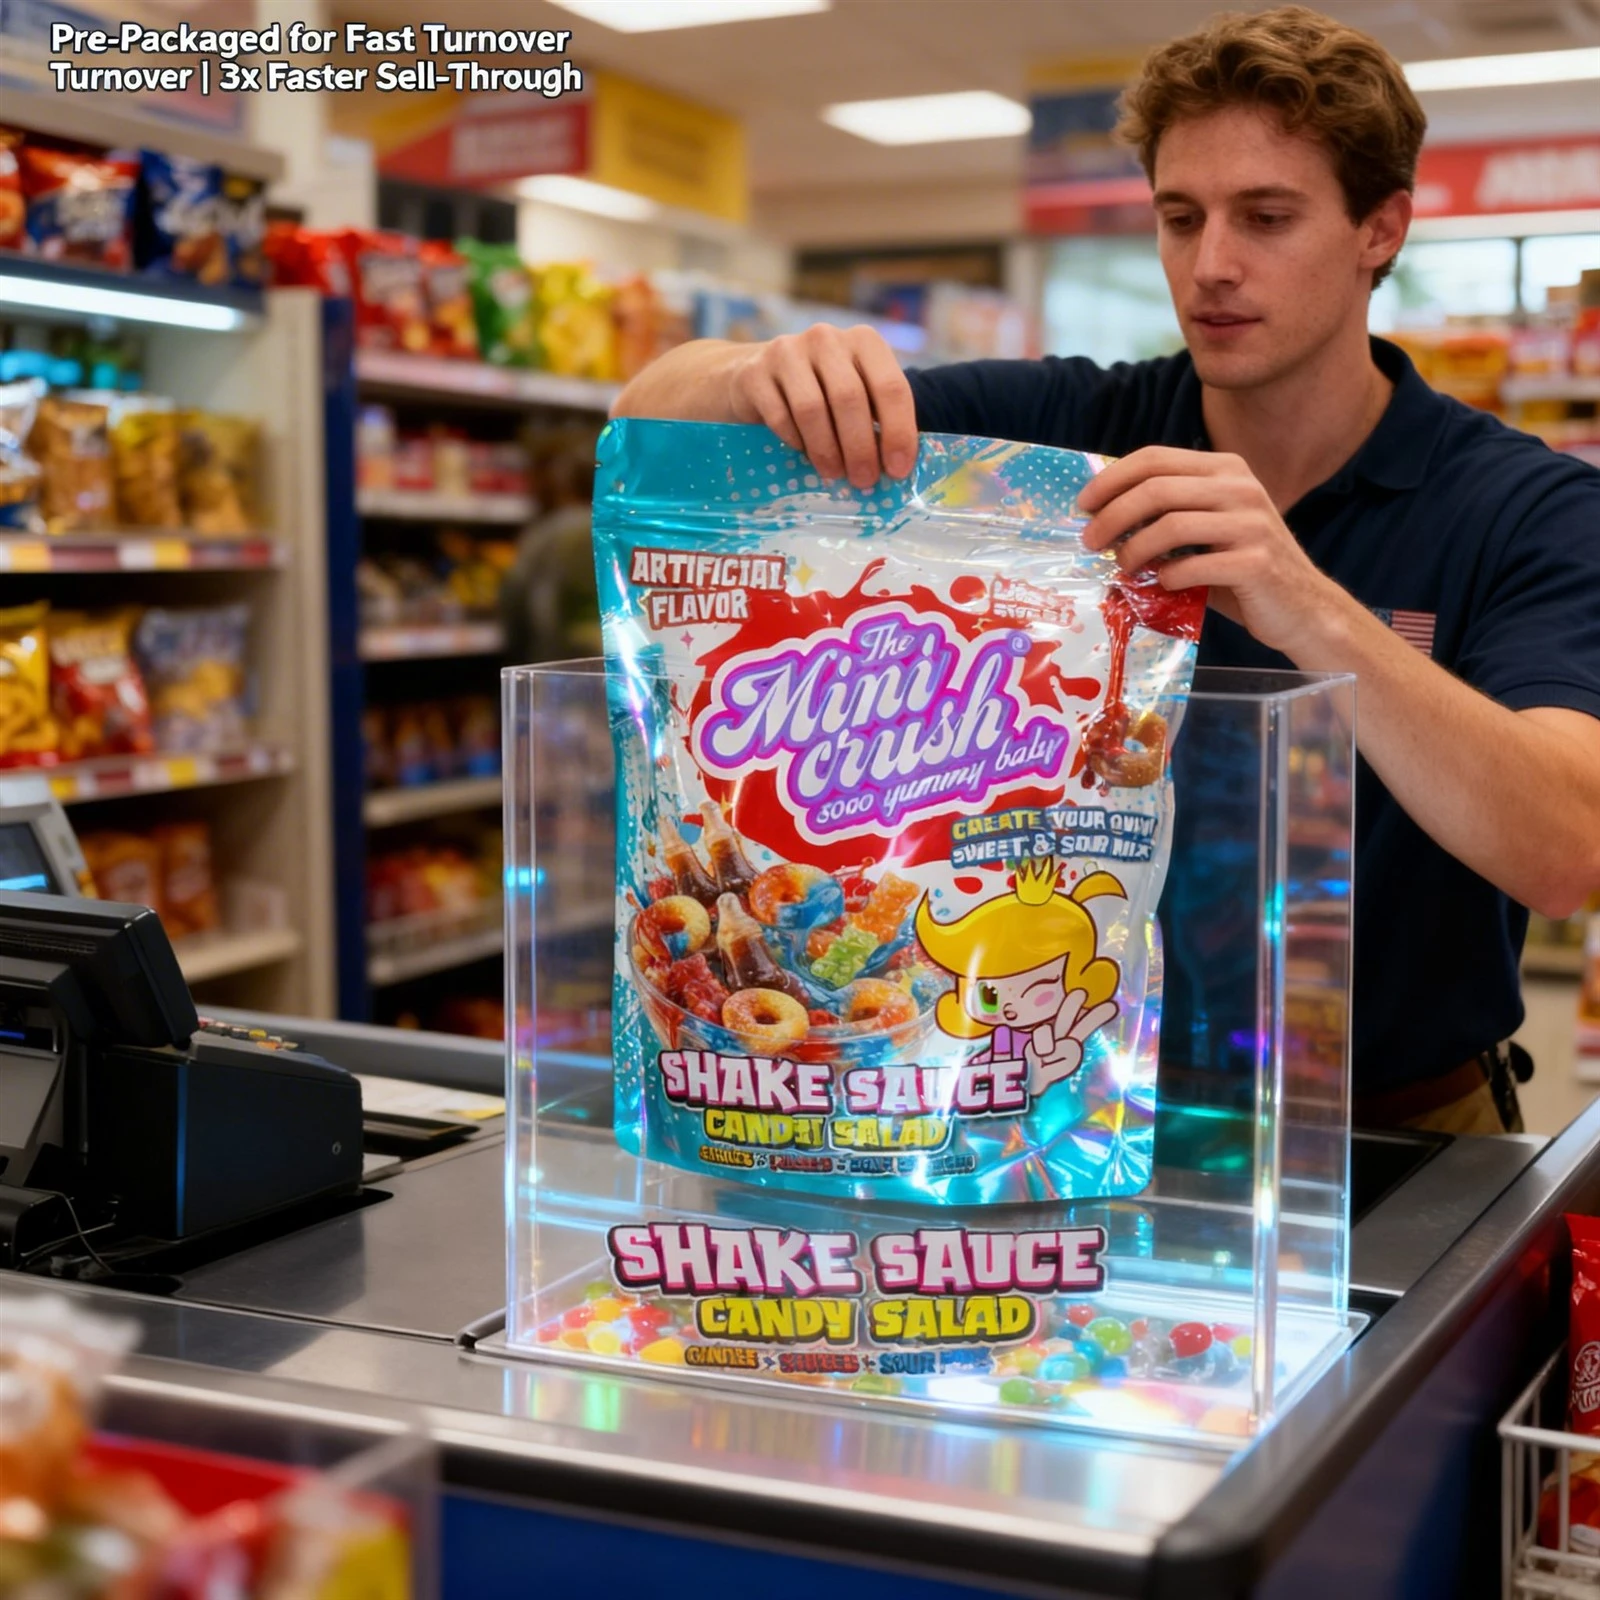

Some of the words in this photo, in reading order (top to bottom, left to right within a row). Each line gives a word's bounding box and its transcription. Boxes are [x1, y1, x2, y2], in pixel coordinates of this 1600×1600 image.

[631, 551, 786, 591] ARTIFICIAL
[652, 588, 749, 626] FLAVOR
[858, 621, 915, 663] The
[713, 630, 942, 757] Mini
[797, 650, 1004, 799] crush
[880, 758, 988, 817] yummy
[659, 1049, 835, 1115] SHAKE
[842, 1058, 1029, 1117] SAUCE
[610, 1223, 863, 1297] SHAKE
[873, 1226, 1106, 1295] SAUCE
[699, 1298, 857, 1344] CANDY
[870, 1296, 1035, 1342] SALAD
